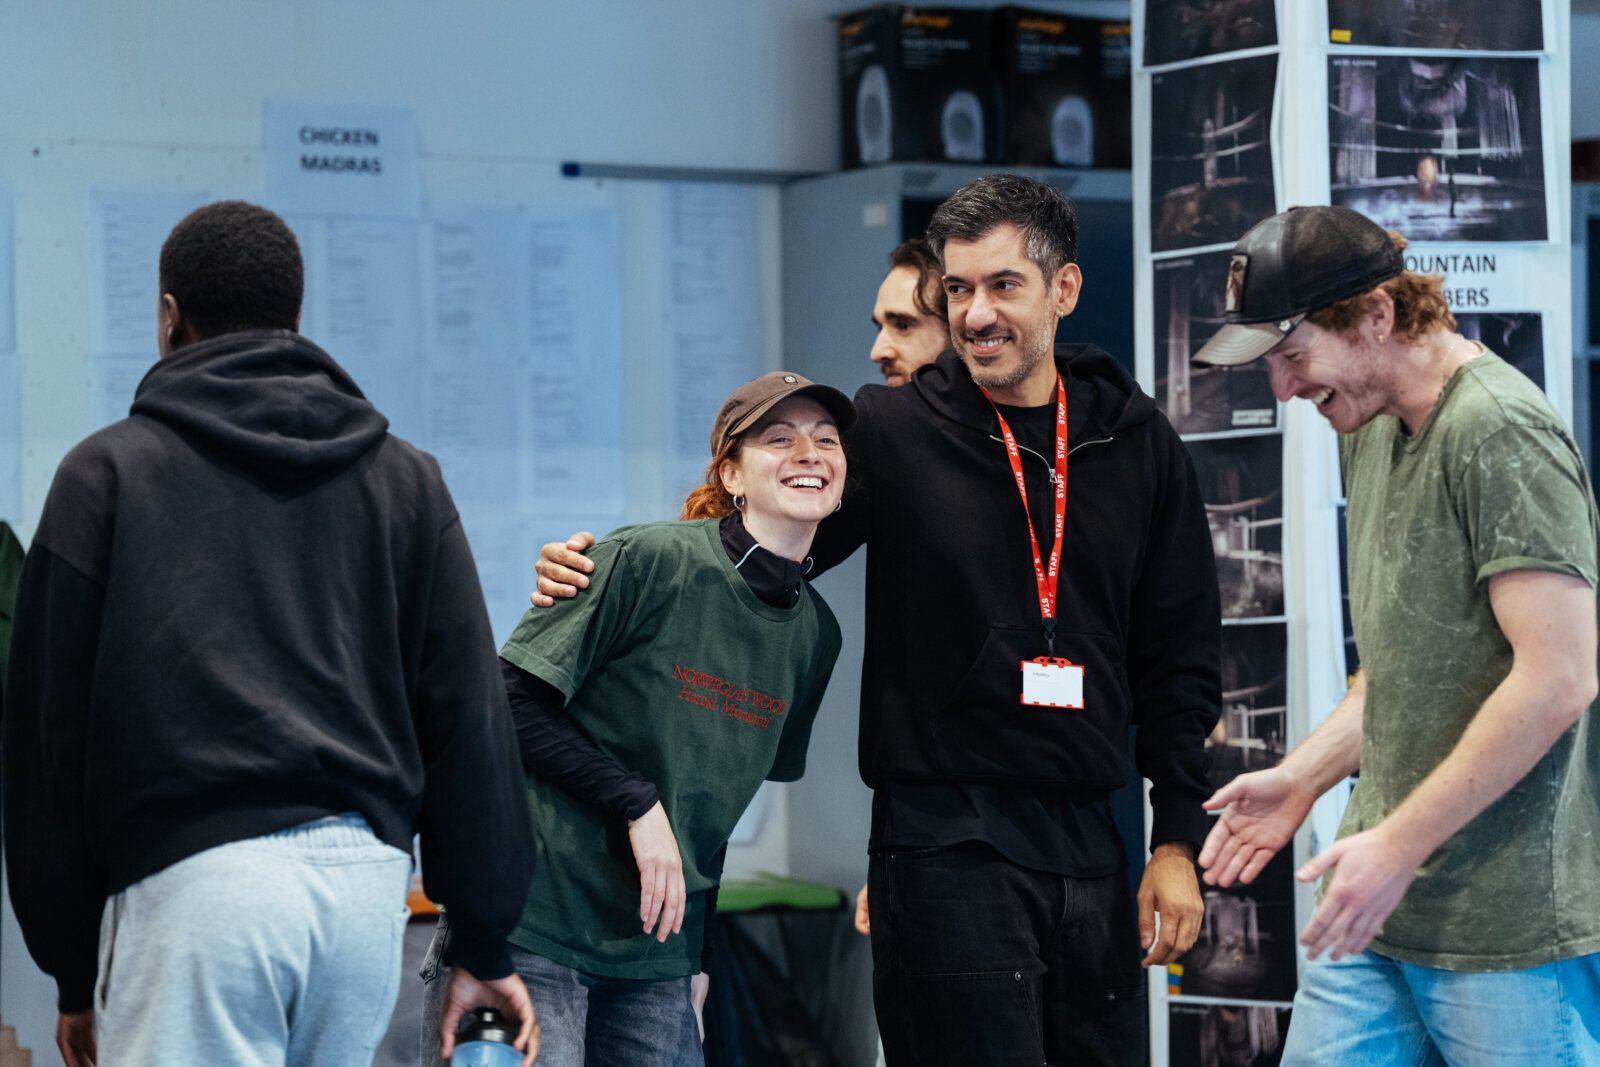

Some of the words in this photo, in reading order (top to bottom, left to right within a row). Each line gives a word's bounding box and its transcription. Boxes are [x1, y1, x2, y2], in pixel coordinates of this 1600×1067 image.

[299, 126, 379, 146] CHICKEN
[300, 154, 382, 175] MADRAS
[1403, 254, 1496, 274] OUNTAIN
[1442, 287, 1490, 306] BERS
[1005, 432, 1018, 457] STAFF
[1057, 436, 1065, 459] STAFF
[1057, 473, 1065, 499] STAFF
[1055, 513, 1063, 538] STAFF
[1048, 551, 1059, 577] STAFF
[671, 663, 750, 702] NORWEGIAN
[678, 685, 717, 711] Haruki
[720, 700, 771, 729] Murakami
